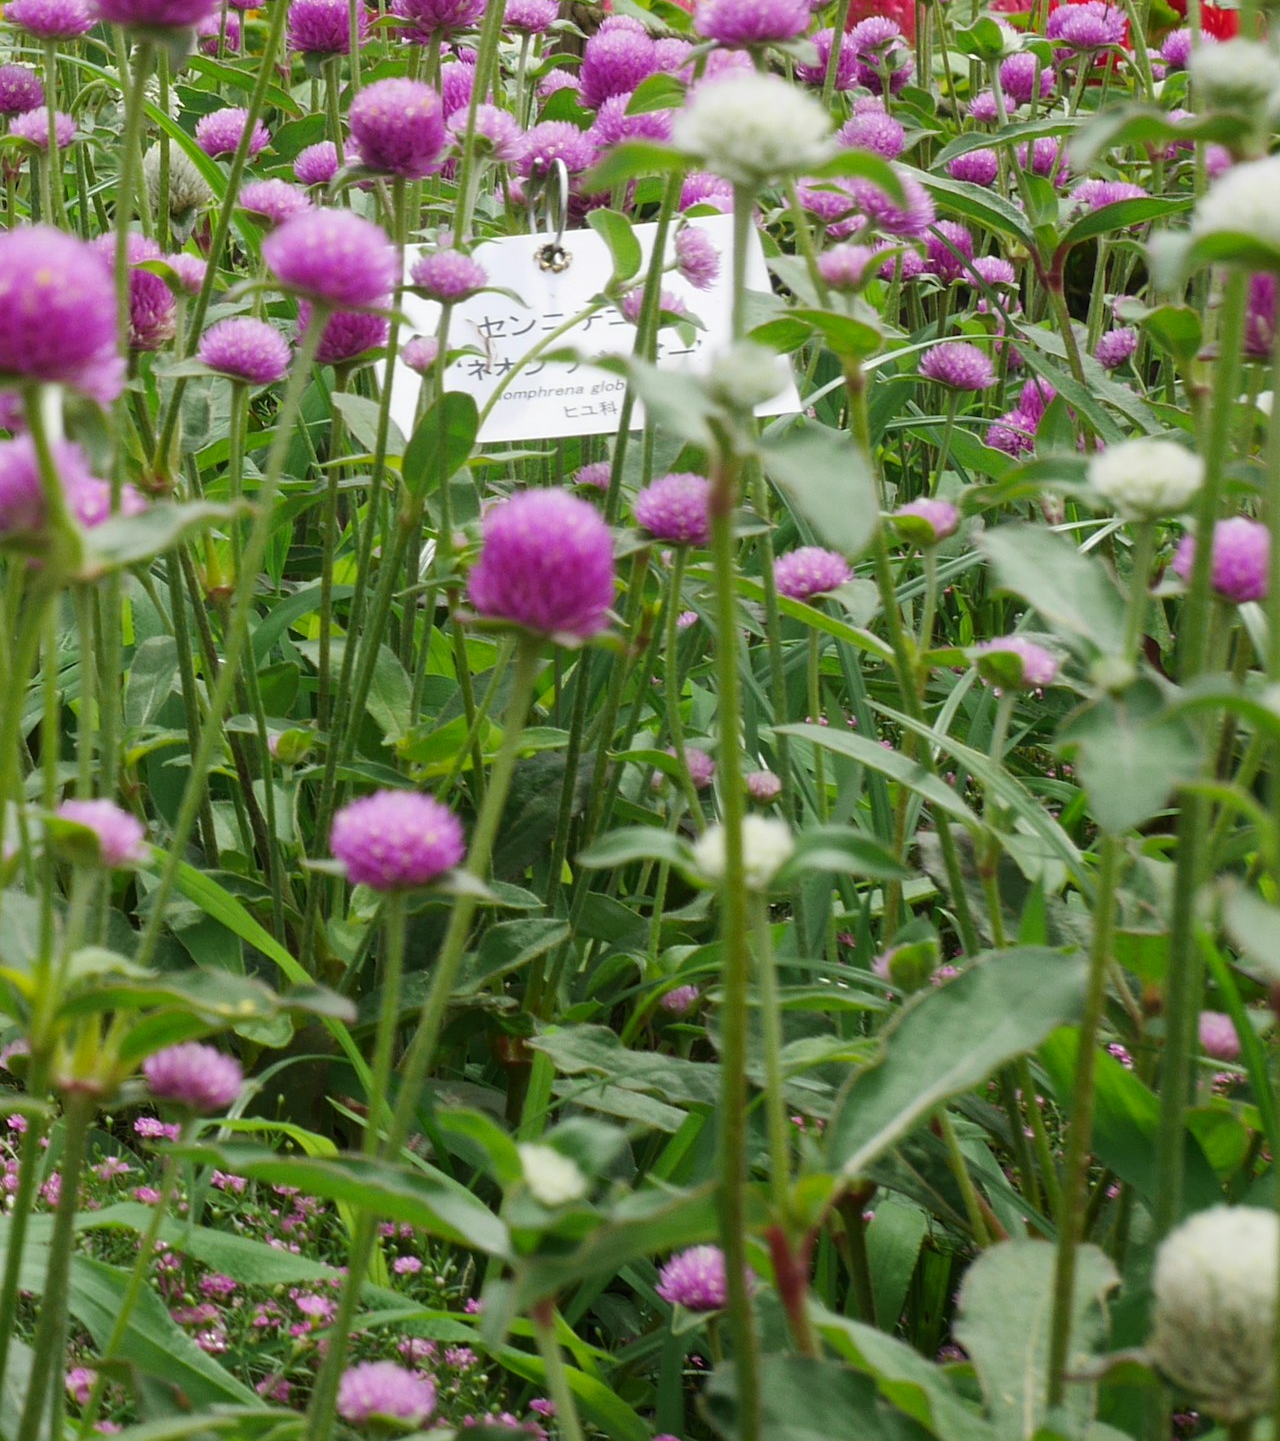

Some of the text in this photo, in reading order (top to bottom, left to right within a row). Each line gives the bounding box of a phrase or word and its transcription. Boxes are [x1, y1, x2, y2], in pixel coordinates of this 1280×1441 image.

[497, 379, 625, 400] omphrena glob
[563, 401, 619, 419] ヒユ科
